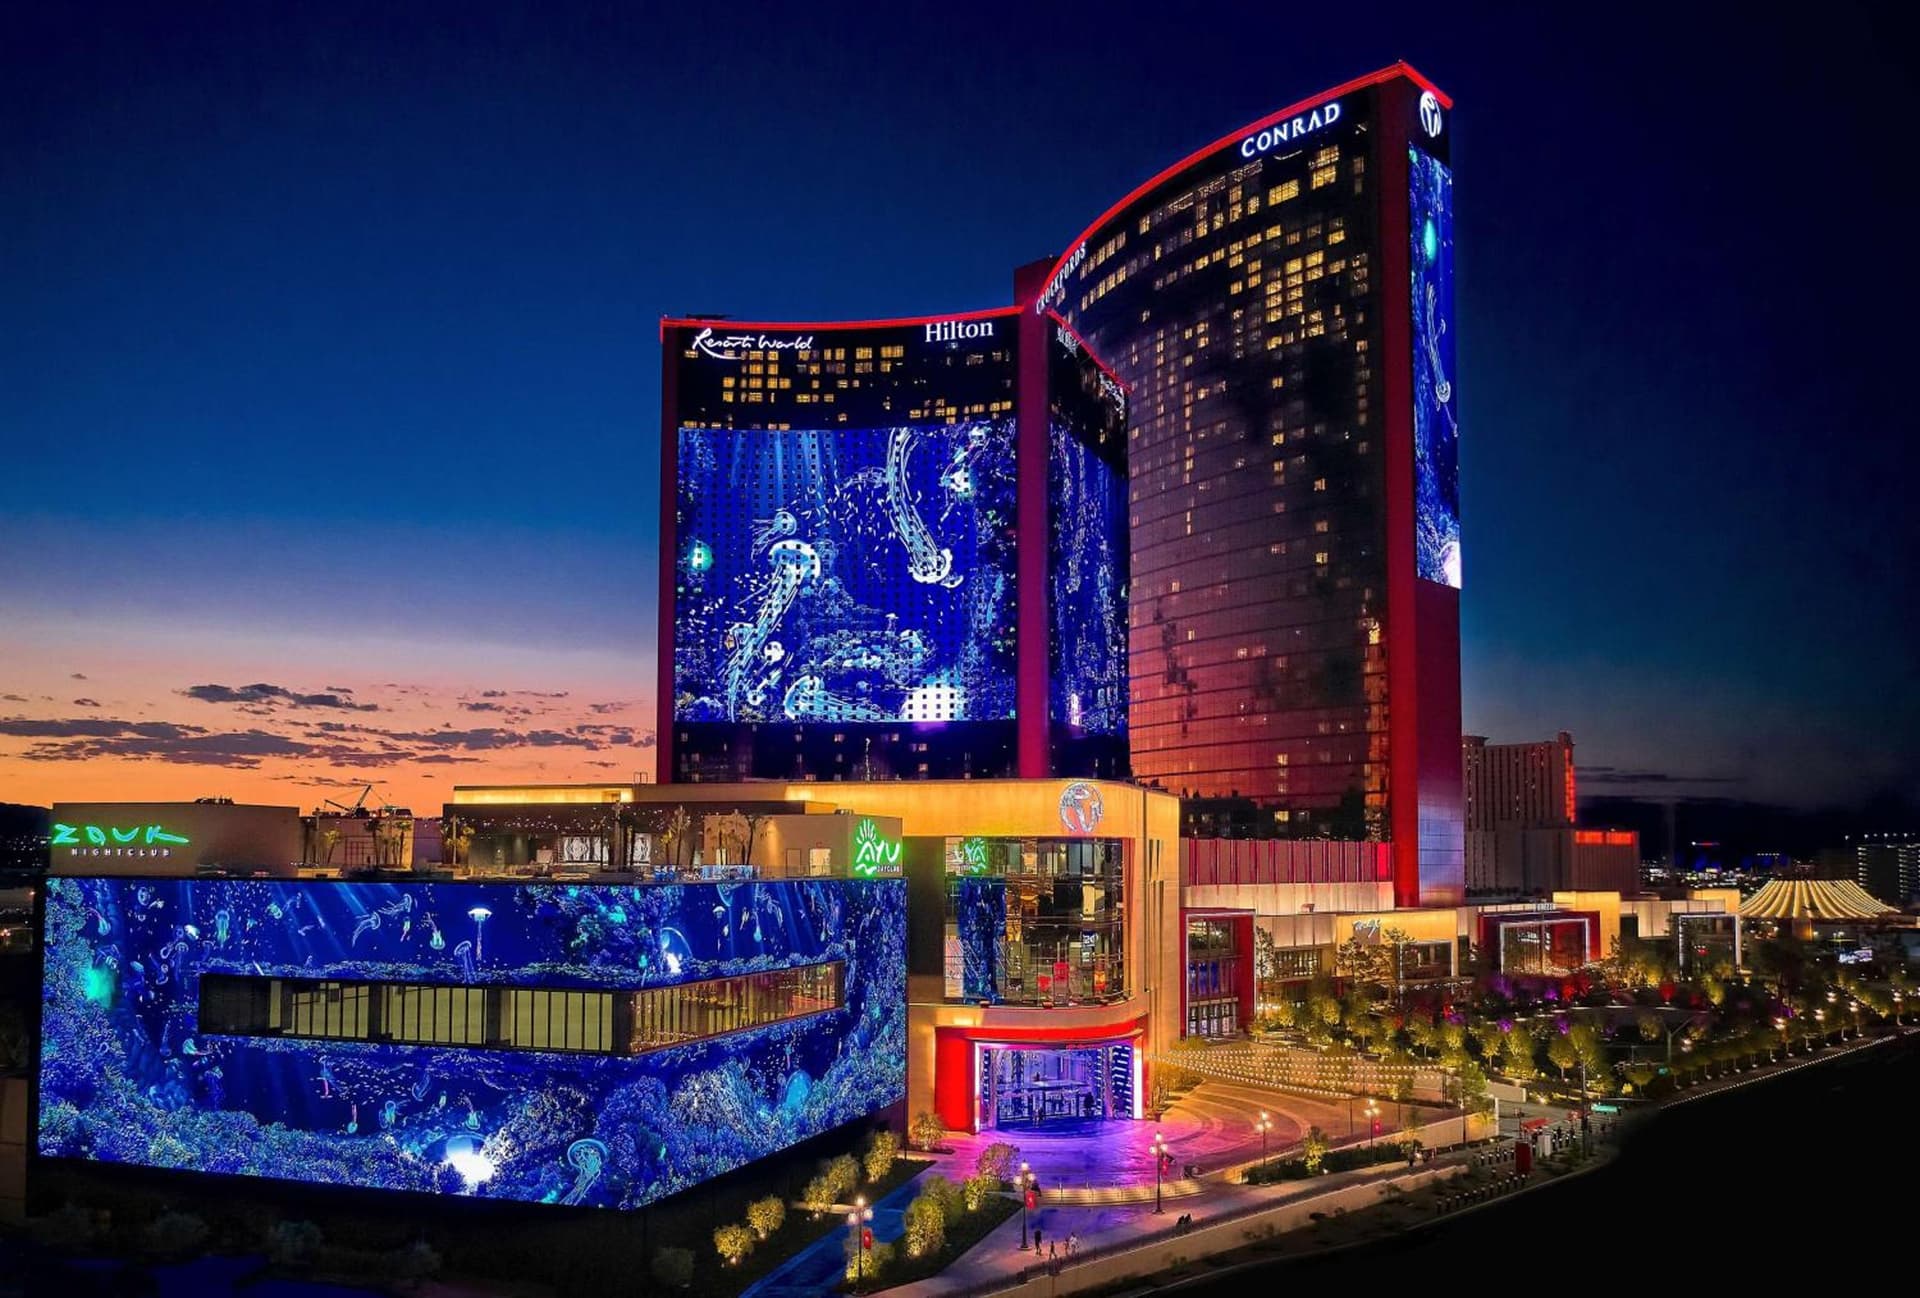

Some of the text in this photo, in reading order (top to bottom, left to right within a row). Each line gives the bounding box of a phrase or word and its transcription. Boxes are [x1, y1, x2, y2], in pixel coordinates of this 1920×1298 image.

[1241, 103, 1340, 157] CONRAD
[925, 320, 994, 342] Hilton
[692, 328, 814, 359] Resorts World
[52, 823, 189, 846] ZOUK
[71, 848, 171, 856] NIGHTCLUB
[855, 839, 900, 863] AYU
